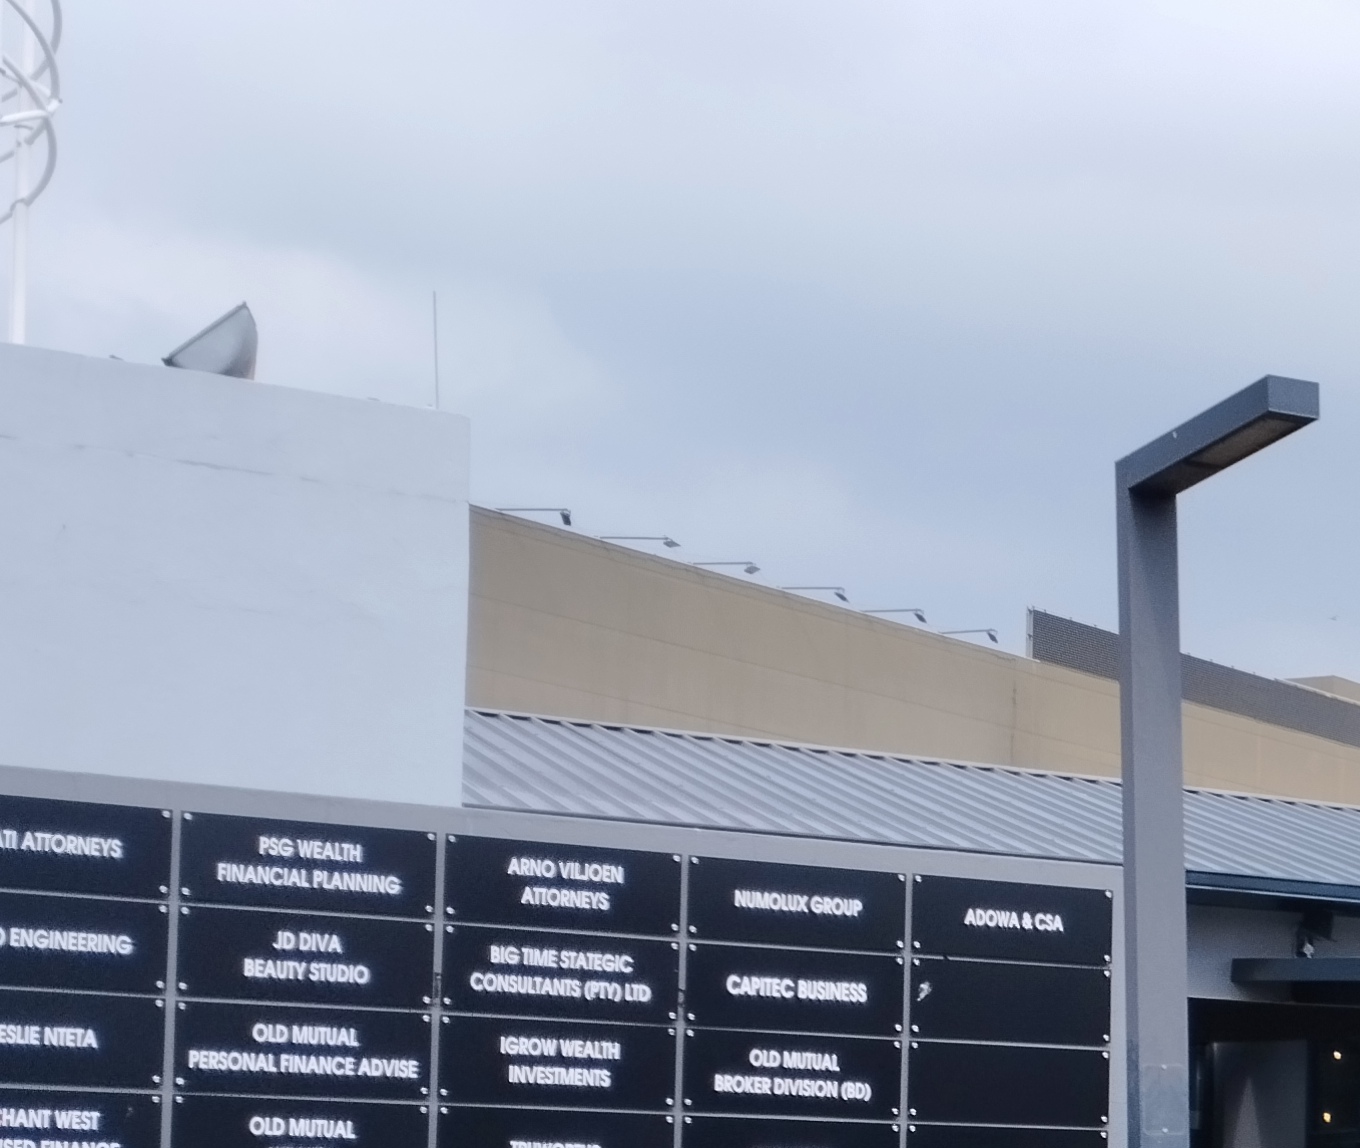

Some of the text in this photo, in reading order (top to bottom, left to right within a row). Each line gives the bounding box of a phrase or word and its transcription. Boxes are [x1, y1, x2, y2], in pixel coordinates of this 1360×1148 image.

[0, 829, 124, 859] TI ATTORNEYS
[258, 835, 364, 863] PSG WEALTH
[217, 862, 403, 895] FINANCIAL PLANNING
[507, 856, 625, 884] ARNO VILJOEN
[520, 886, 611, 911] ATTORNEYS
[733, 889, 864, 917] NUMOLUX GROUP
[963, 908, 1064, 932] ADOWA & CSA
[9, 927, 134, 955] ENGINEERING
[272, 930, 344, 954] JD DIVA
[243, 957, 371, 985] BEAUTY STUDIO
[489, 945, 635, 974] BIG TIME STATEGIC
[469, 972, 652, 1003] CONSULTANTS (PTY) LTD
[725, 974, 868, 1003] CAPITEC BUSINESS
[43, 1026, 99, 1049] NTETA
[252, 1022, 361, 1047] OLD MUTUAL
[500, 1036, 621, 1060] IGROW WEALTH
[188, 1049, 420, 1079] PERSONAL FINANCE ADVISE
[749, 1048, 841, 1072] OLD MUTUAL
[508, 1065, 612, 1088] INVESTMENTS
[713, 1073, 873, 1102] BROKER DIVISION (BD)
[0, 1108, 102, 1131] HANT WEST
[249, 1115, 358, 1140] OLD MUTUAL
